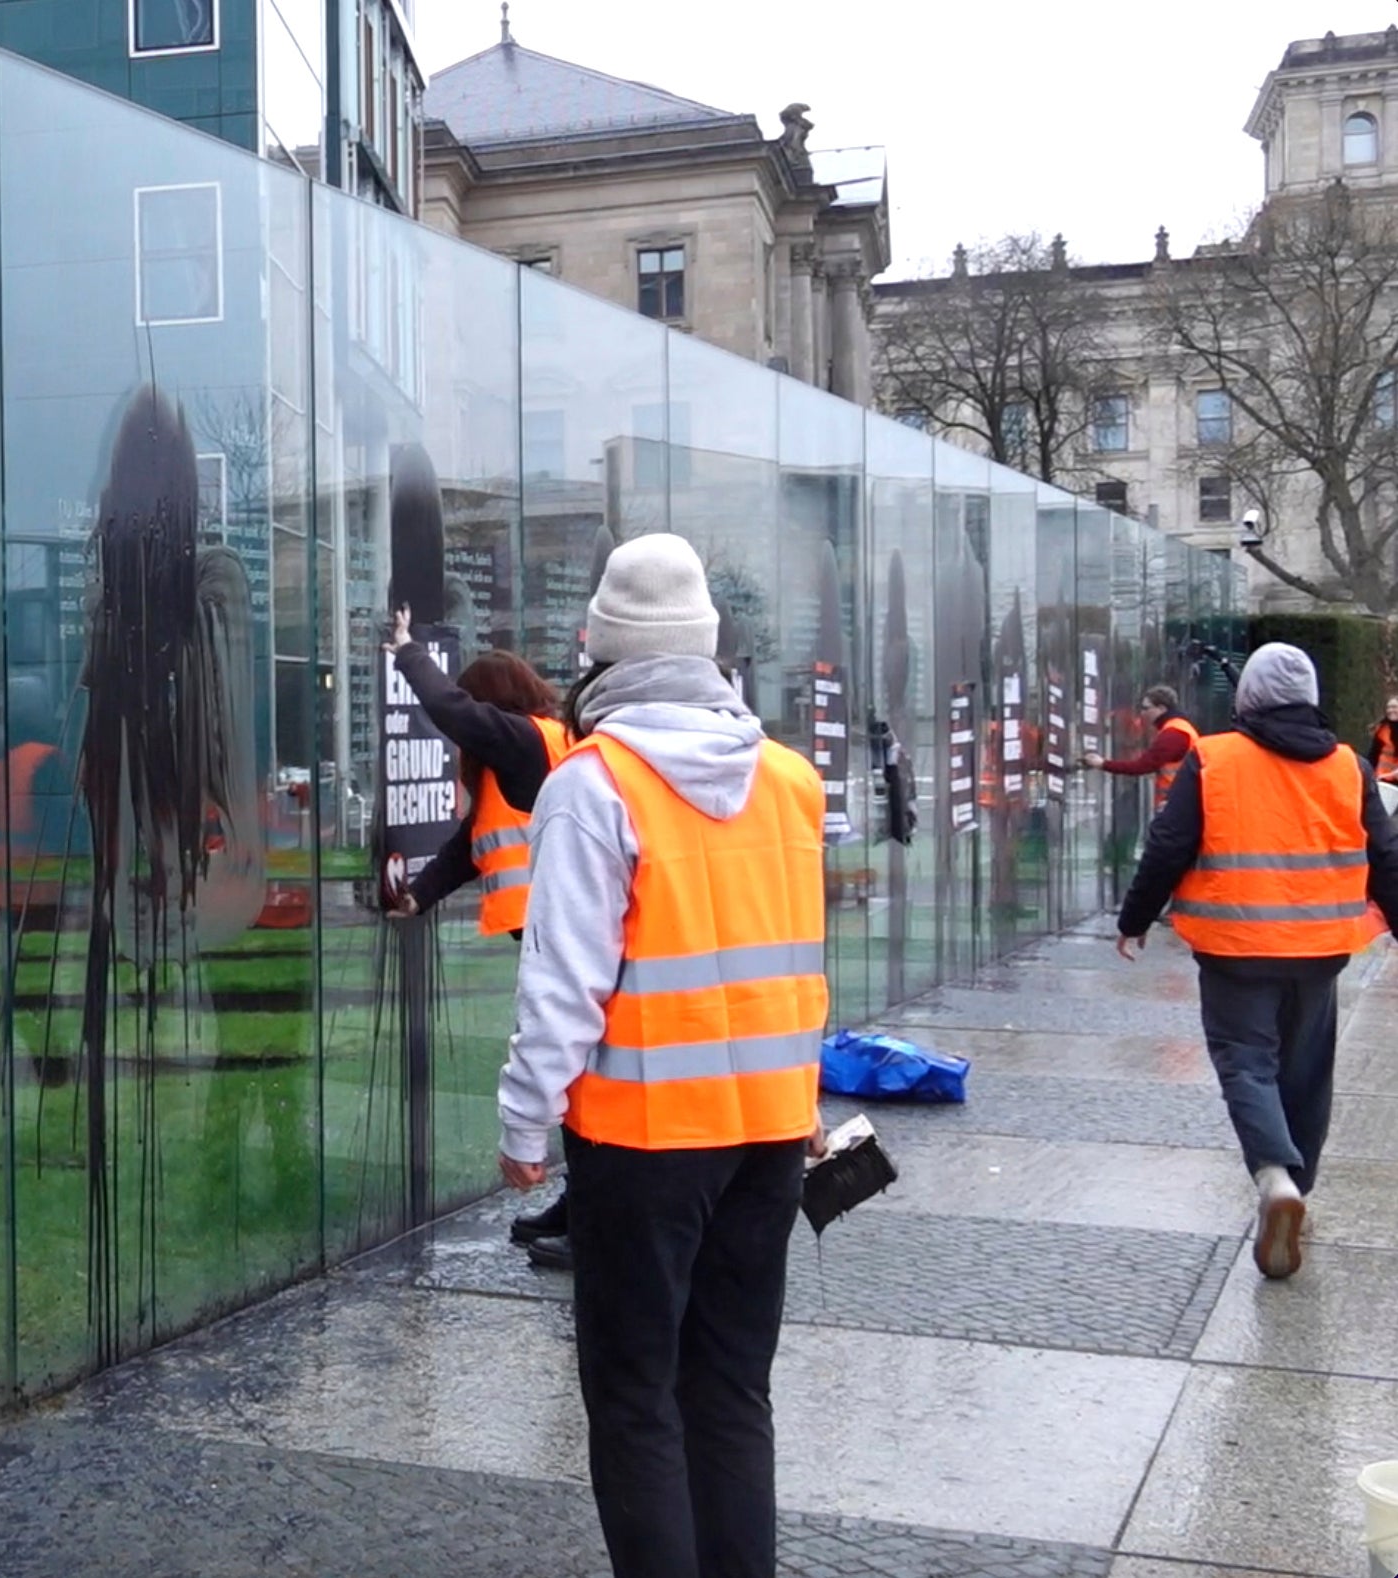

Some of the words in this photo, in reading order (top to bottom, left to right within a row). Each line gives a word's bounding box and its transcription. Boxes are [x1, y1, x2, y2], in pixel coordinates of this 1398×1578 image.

[385, 710, 410, 736] oder
[386, 739, 450, 782] GRUND-
[386, 780, 456, 827] RECHTE?
